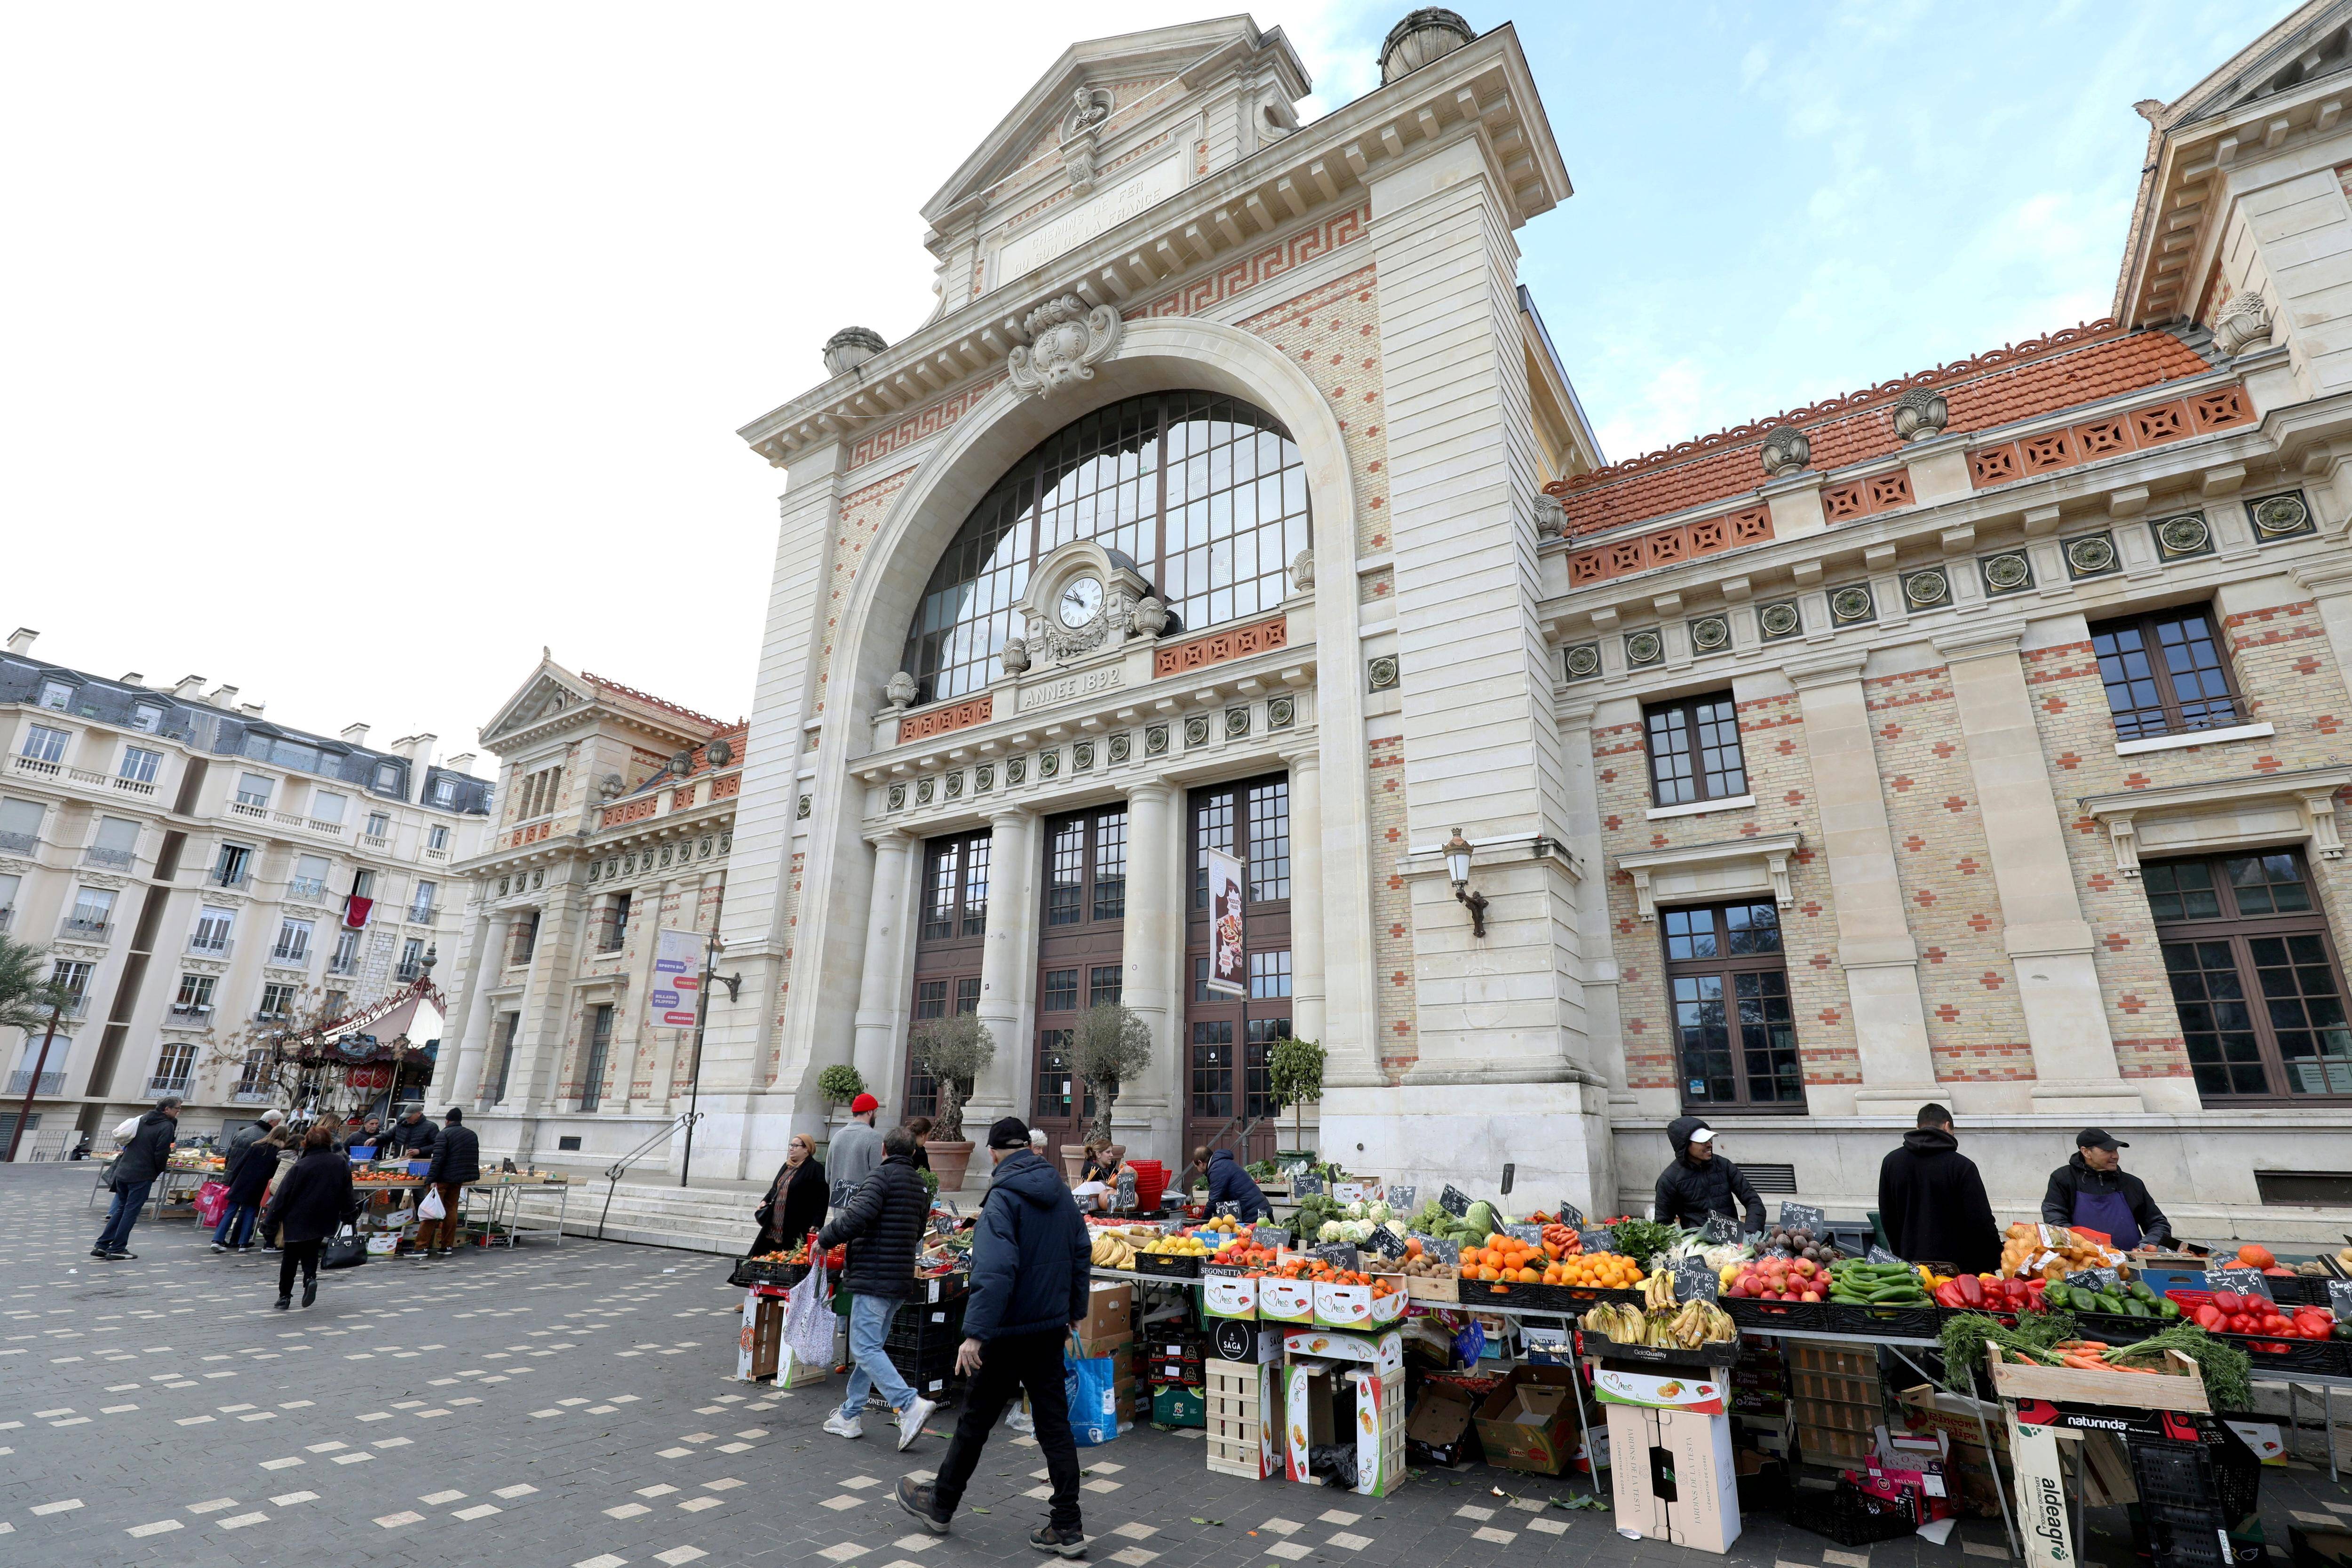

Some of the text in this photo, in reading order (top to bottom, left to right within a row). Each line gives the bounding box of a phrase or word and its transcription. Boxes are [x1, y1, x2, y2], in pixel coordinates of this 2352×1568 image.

[1032, 181, 1144, 249] CHEMINS DE FER
[1014, 188, 1160, 275] DU SUD DE LA FRANCE
[1025, 668, 1120, 707] ANNEE 1892
[1200, 1267, 1241, 1276] SEGONETTA
[1676, 1261, 1714, 1281] Bananes
[1224, 1341, 1241, 1350] SAGA
[1634, 1349, 1667, 1358] GoldQuality
[1929, 1411, 1972, 1428] Rincón
[2068, 1416, 2126, 1430] naturinda
[1627, 1428, 1636, 1461] JARDINS
[1630, 1462, 1637, 1473] DE
[1689, 1465, 1696, 1476] LA
[1632, 1475, 1638, 1485] LA
[1690, 1477, 1697, 1488] DE
[2034, 1476, 2043, 1504] EXPLOTACIÓ
[1691, 1490, 1701, 1524] JARDINS
